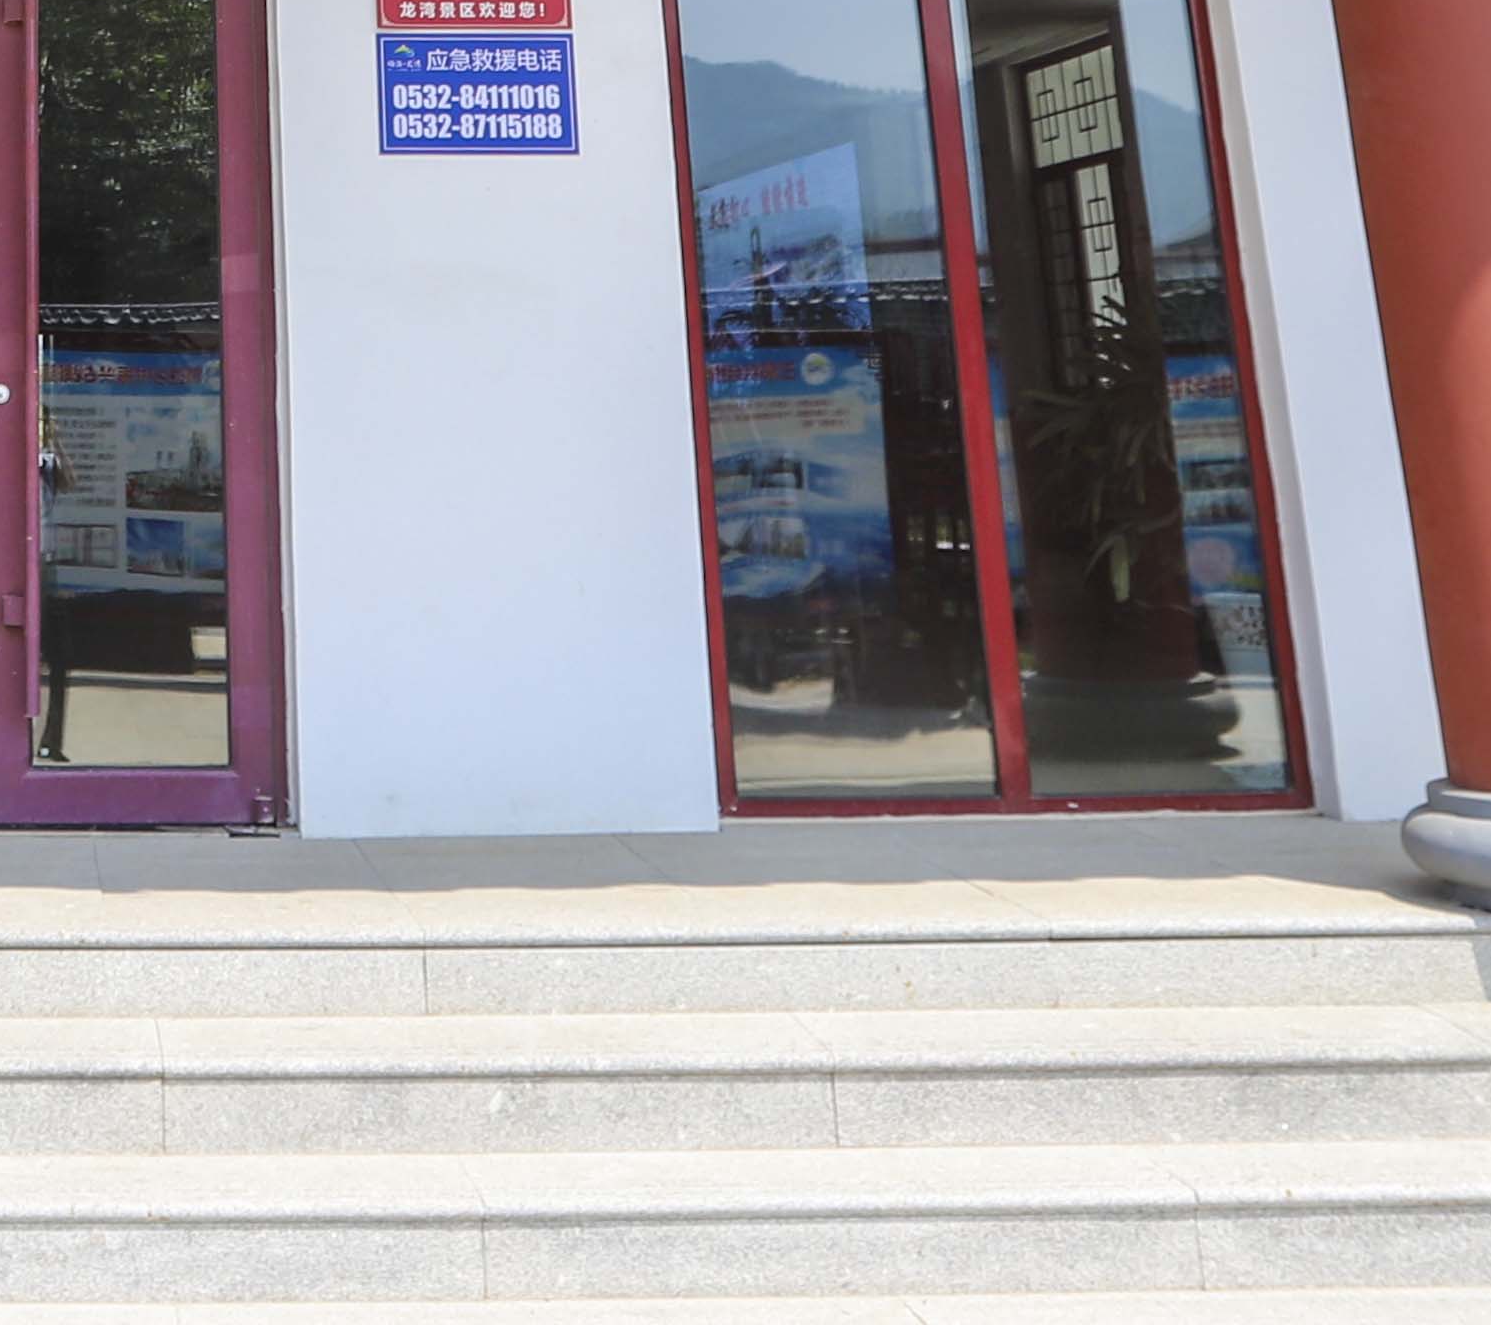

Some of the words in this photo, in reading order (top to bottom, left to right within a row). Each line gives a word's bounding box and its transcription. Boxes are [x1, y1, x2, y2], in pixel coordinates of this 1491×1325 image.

[426, 49, 563, 72] 应急救援电话
[393, 84, 560, 110] 0532-84111016
[393, 113, 563, 139] 0532-87115188
